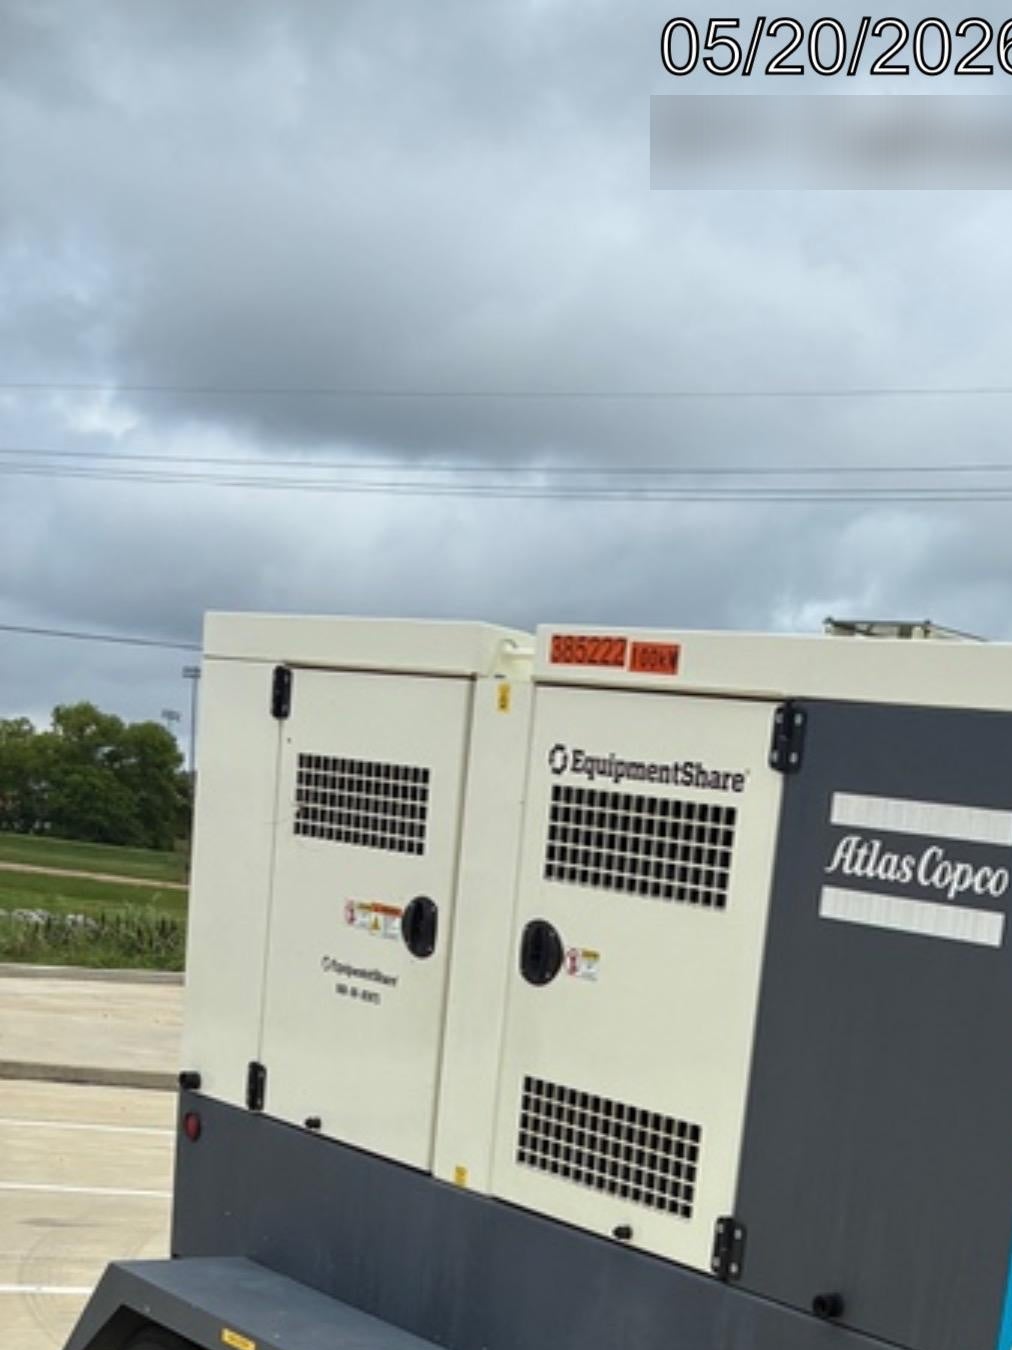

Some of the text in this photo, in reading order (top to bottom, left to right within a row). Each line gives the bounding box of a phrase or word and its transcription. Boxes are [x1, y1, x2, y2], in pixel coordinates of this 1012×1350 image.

[571, 749, 746, 793] EquipmentShare
[824, 835, 1010, 900] Atlas Copco
